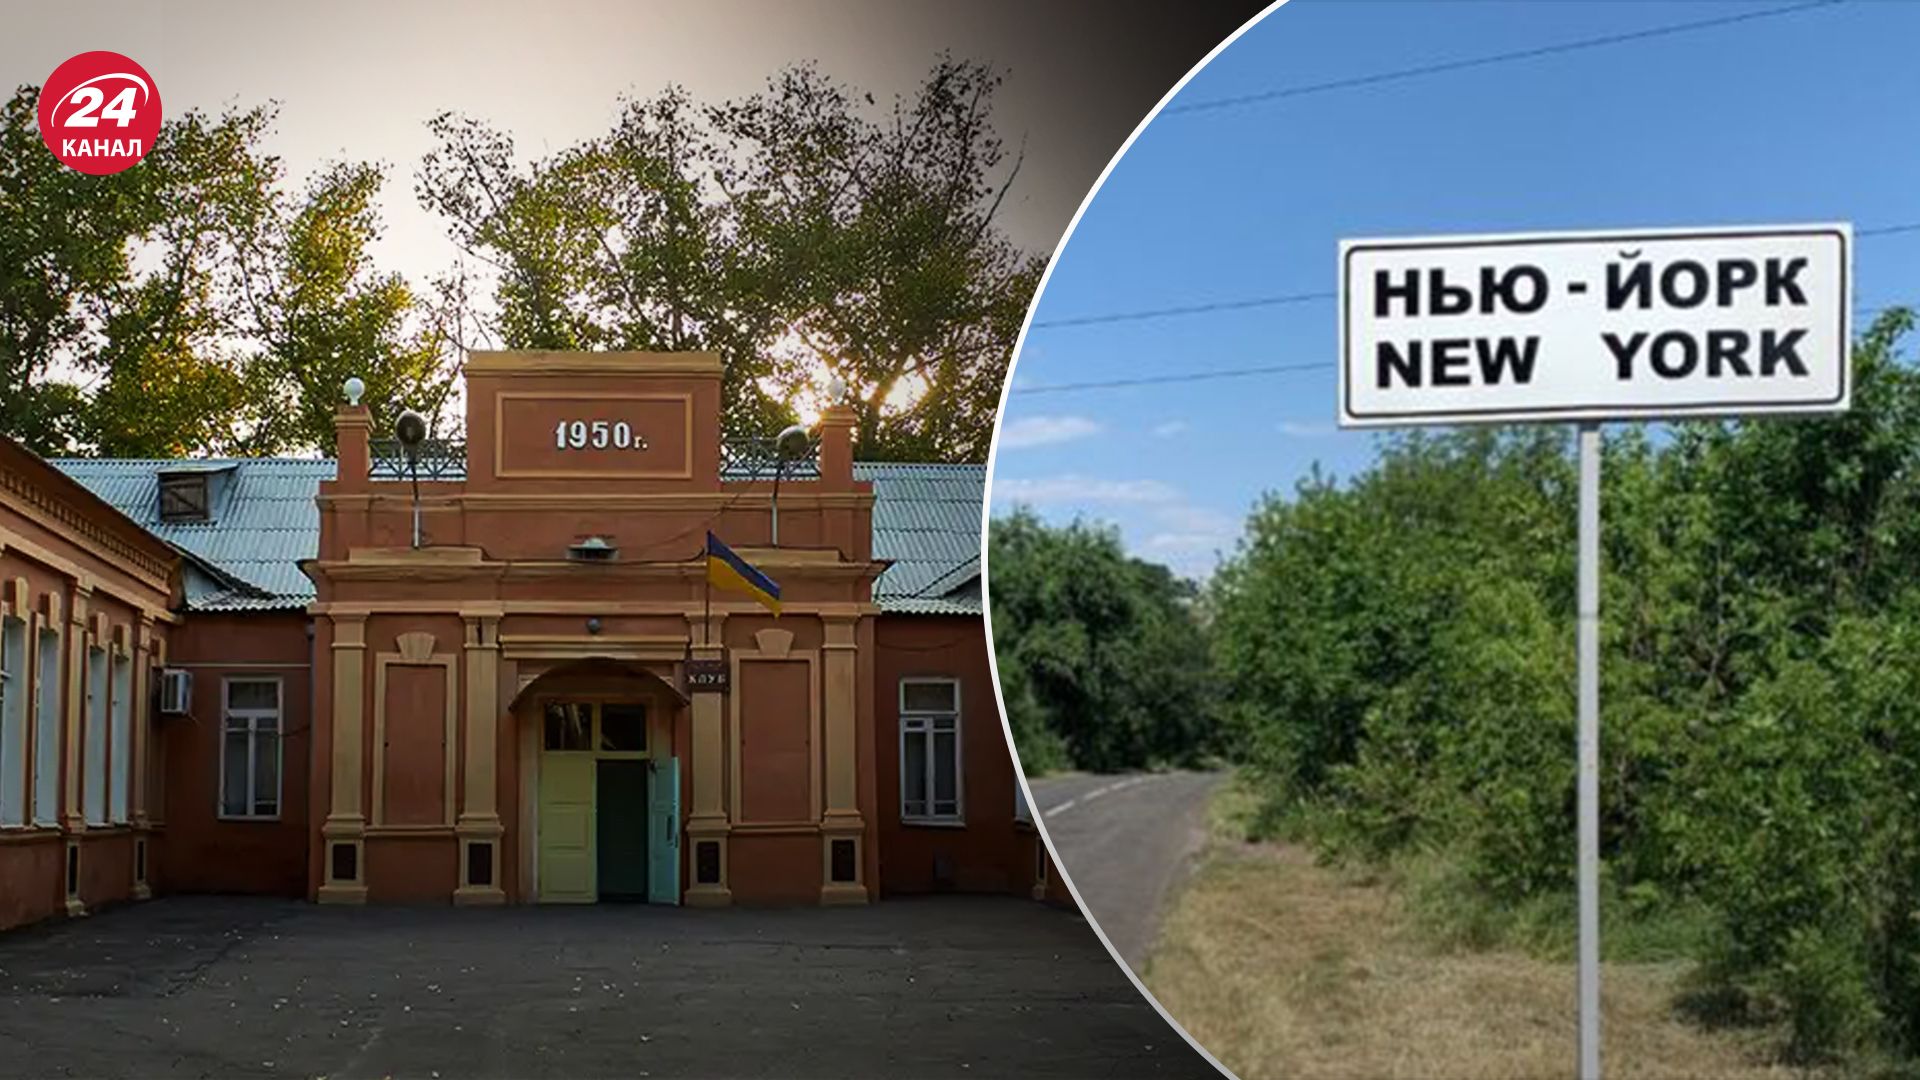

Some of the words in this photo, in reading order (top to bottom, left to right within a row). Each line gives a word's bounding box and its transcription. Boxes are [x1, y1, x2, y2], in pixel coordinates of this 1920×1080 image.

[1373, 265, 1550, 318] НЬЮ
[1604, 248, 1809, 311] ЙОРК
[1376, 336, 1541, 389] NEW
[1600, 328, 1810, 381] YORK
